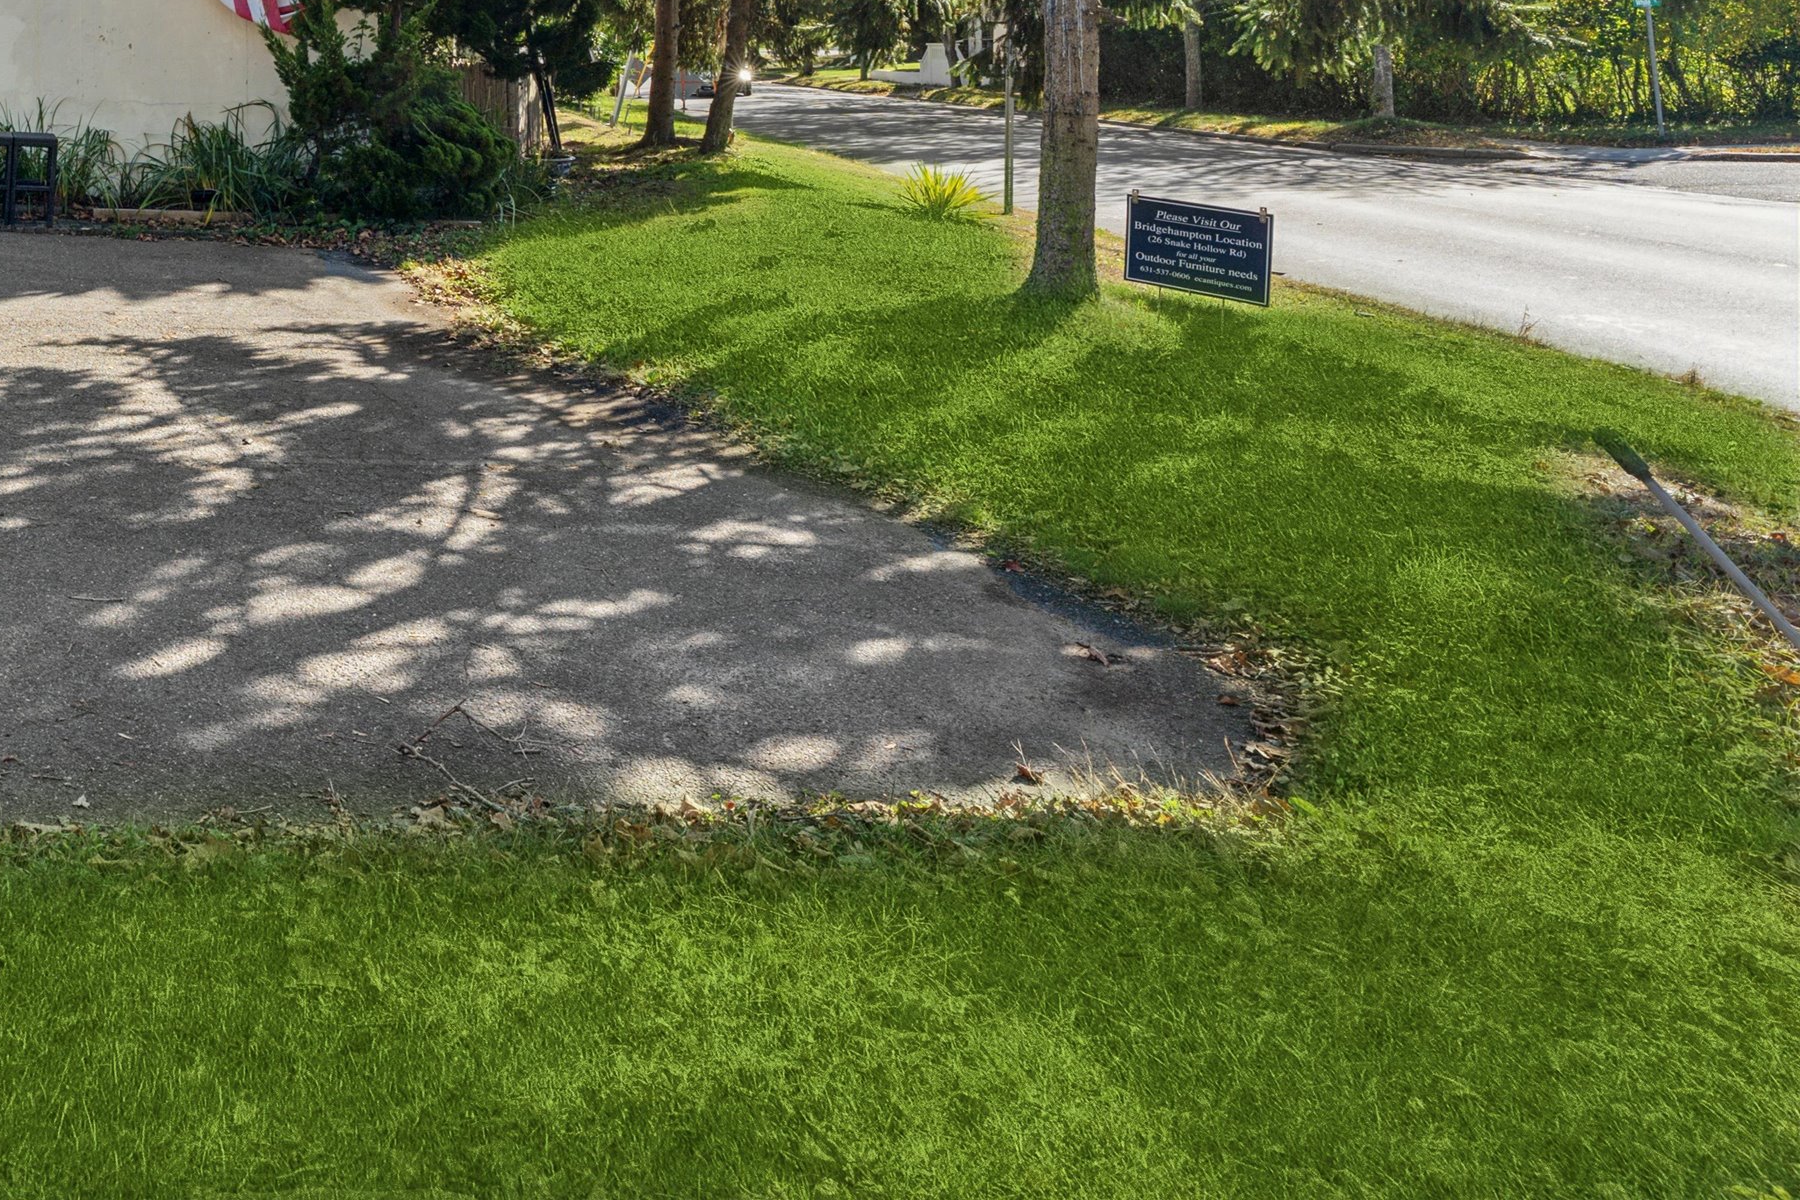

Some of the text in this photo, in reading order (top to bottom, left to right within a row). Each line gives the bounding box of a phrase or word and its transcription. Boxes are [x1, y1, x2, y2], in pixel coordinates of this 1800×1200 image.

[1156, 210, 1242, 231] Please Visit Our
[1134, 221, 1263, 250] Bridgehampton Location
[1147, 235, 1247, 259] (26 Snake Hollow Rd)
[1135, 252, 1259, 281] Outdoor Furniture needs
[1176, 251, 1217, 264] for all your
[1140, 265, 1253, 292] 631-537-0606 ecantiques.com
